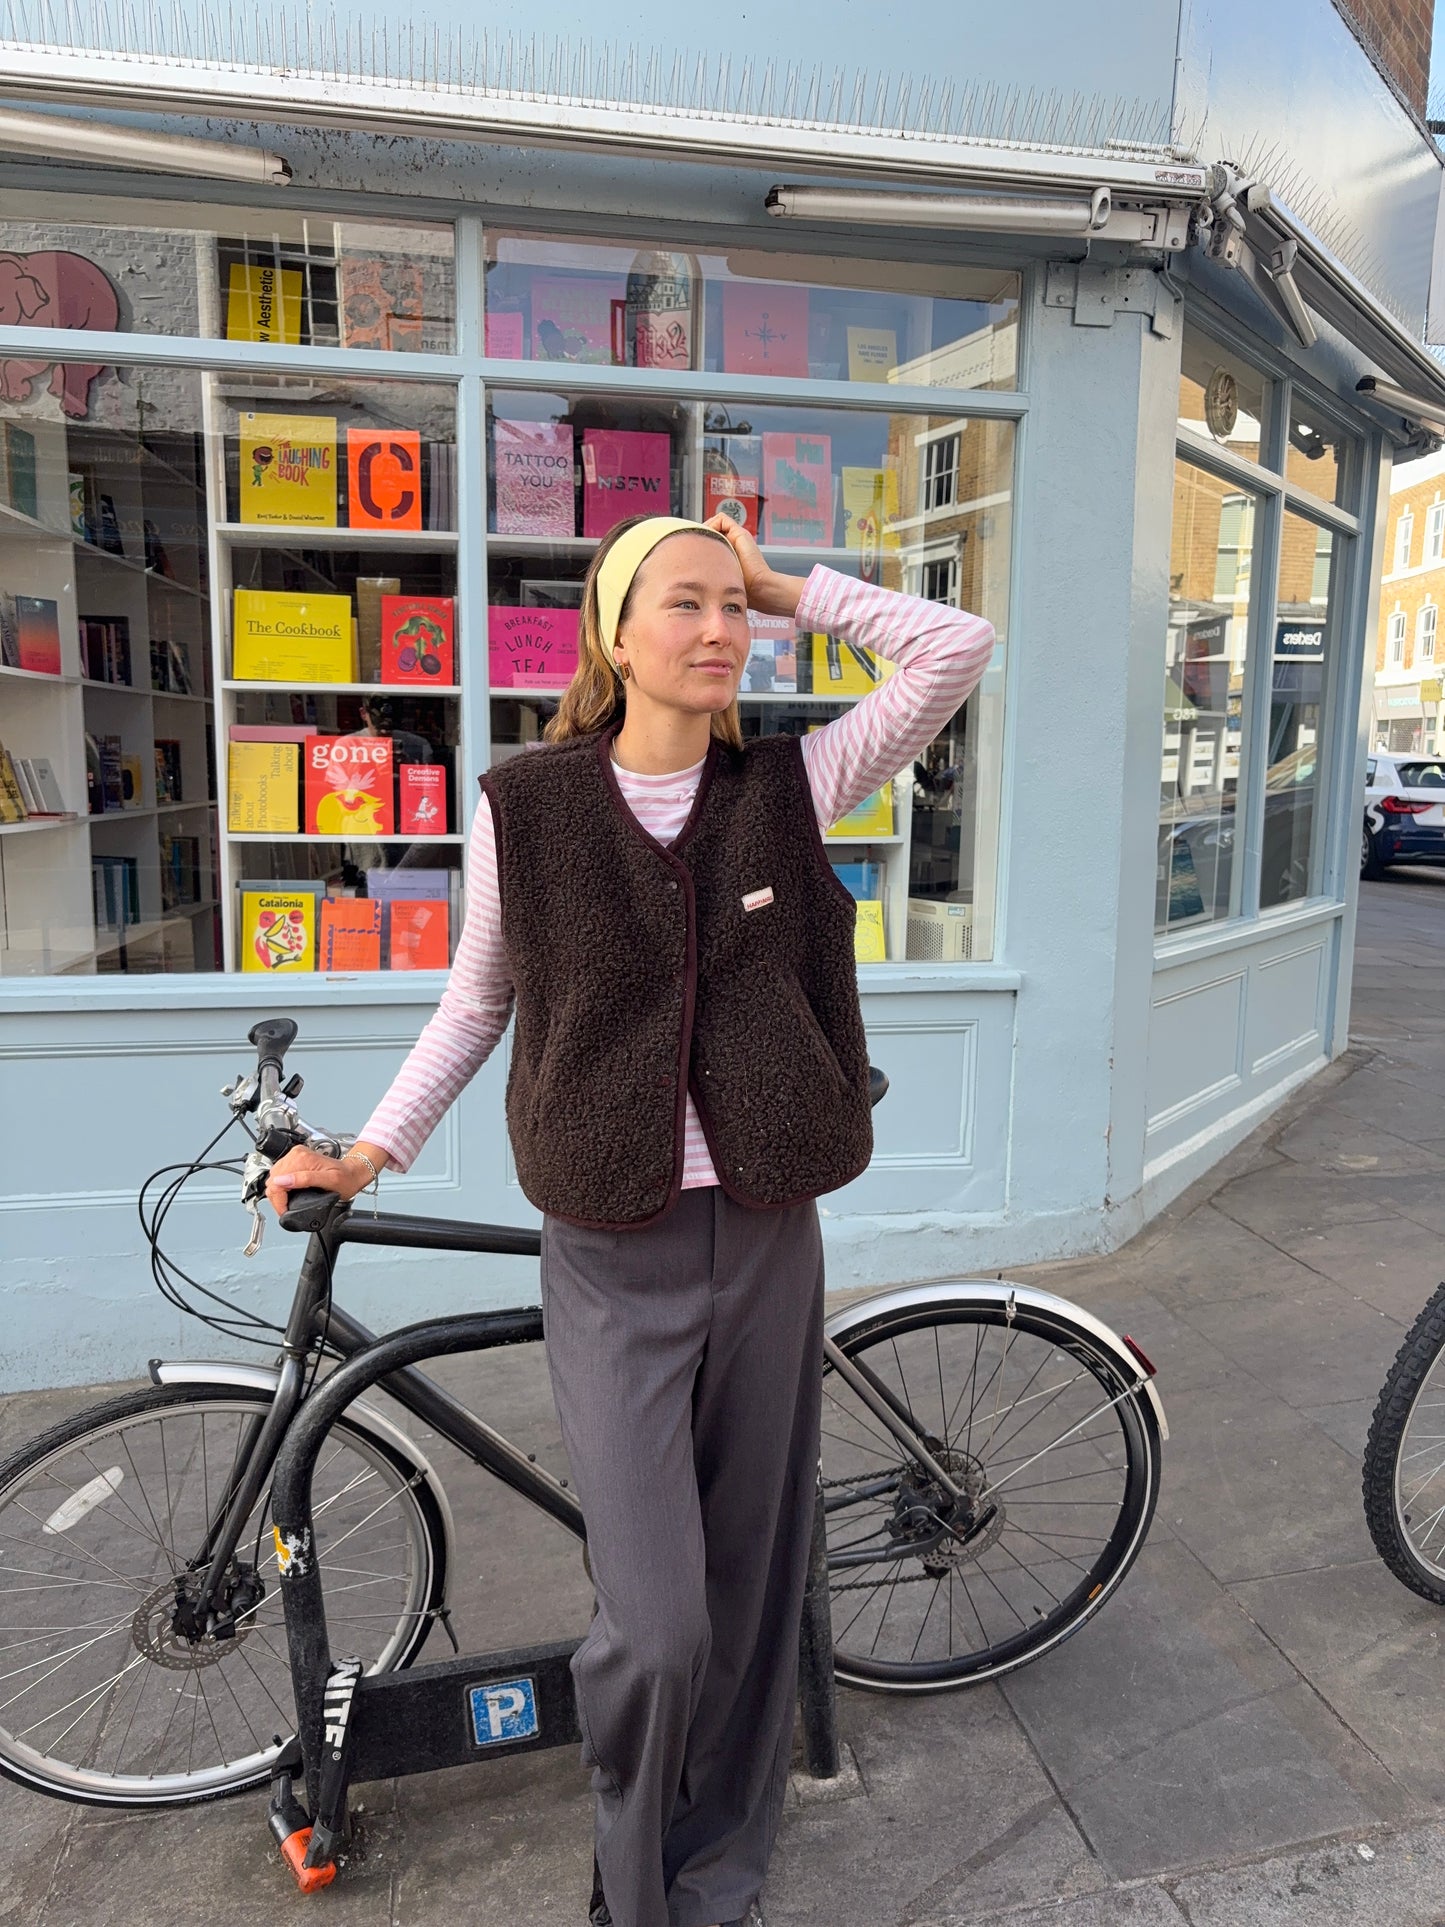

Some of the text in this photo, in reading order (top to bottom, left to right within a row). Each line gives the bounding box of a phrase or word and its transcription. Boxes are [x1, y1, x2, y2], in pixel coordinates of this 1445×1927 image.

[258, 270, 274, 328] Aesthetic
[278, 447, 330, 469] LAUGHING
[505, 453, 568, 468] TATTOO
[278, 464, 309, 487] BOOK
[358, 442, 413, 519] C
[519, 474, 553, 488] YOU
[597, 475, 662, 492] NSFW
[246, 620, 341, 637] The Cookbook
[504, 616, 554, 631] BREAKFAST
[504, 634, 553, 653] LUNCH
[512, 658, 545, 673] TEA
[270, 745, 283, 778] Talking
[284, 746, 293, 772] about
[312, 743, 388, 769] gone
[407, 768, 440, 776] Creative
[408, 775, 439, 783] Demons
[231, 793, 244, 826] Talking
[257, 775, 267, 828] Photobooks
[245, 802, 254, 828] about
[258, 898, 304, 908] Catalonia
[486, 1687, 526, 1737] P
